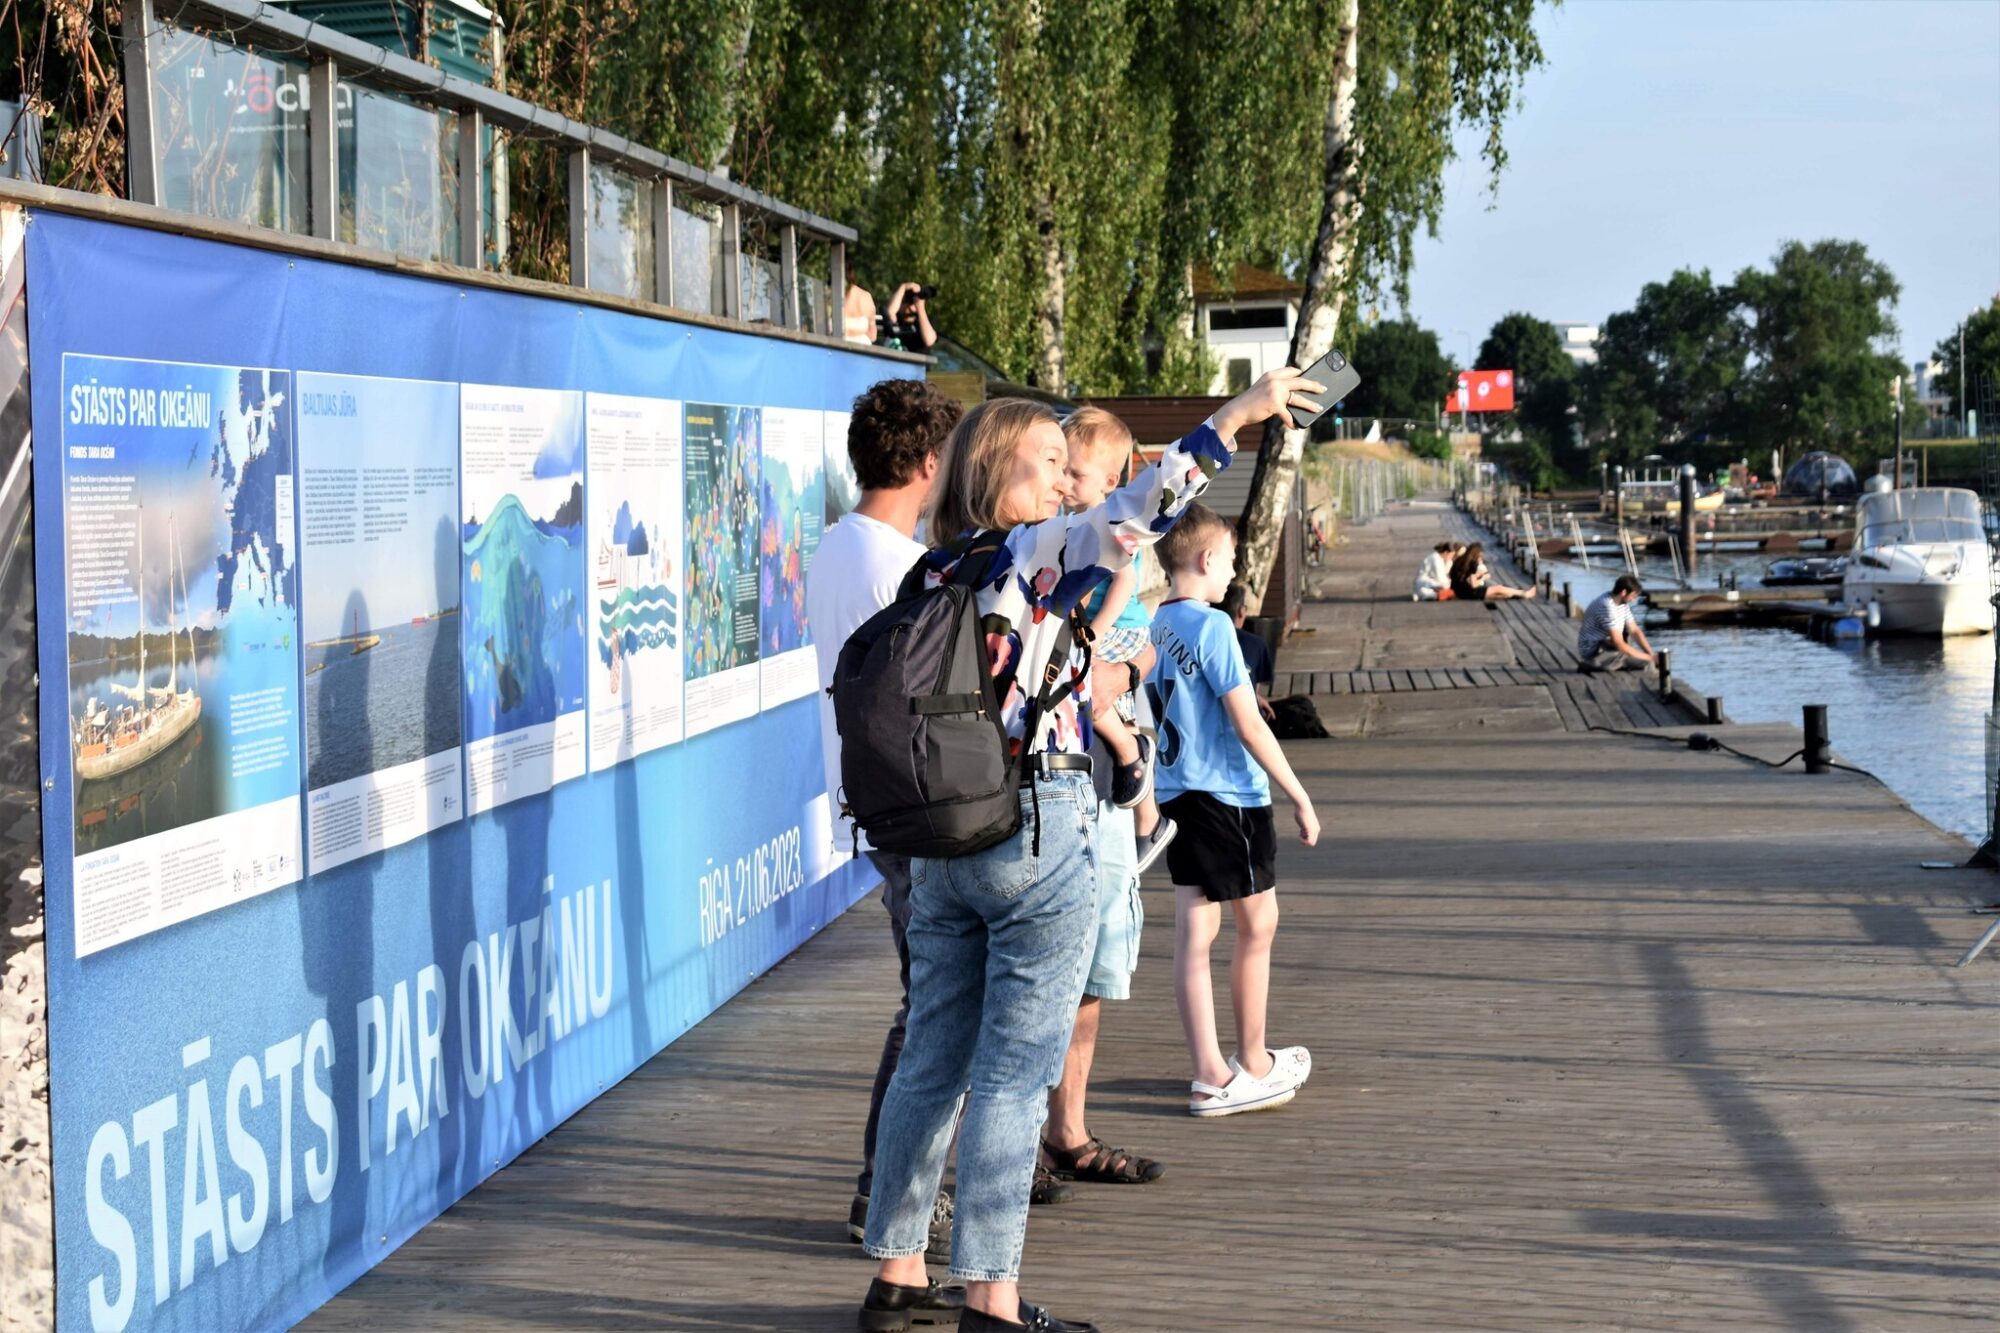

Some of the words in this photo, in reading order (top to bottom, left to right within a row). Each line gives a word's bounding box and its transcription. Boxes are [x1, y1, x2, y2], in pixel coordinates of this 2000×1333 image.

[70, 378, 126, 426] STĀSTS
[129, 388, 157, 427] PAR
[160, 384, 210, 429] OKEĀNU
[303, 392, 337, 416] BALTIJAS
[699, 858, 734, 947] RĪGA
[736, 826, 804, 925] 21.06.2023.
[85, 1018, 339, 1333] STĀSTS
[357, 963, 449, 1172] PAR
[459, 875, 613, 1099] OKEĀNU
